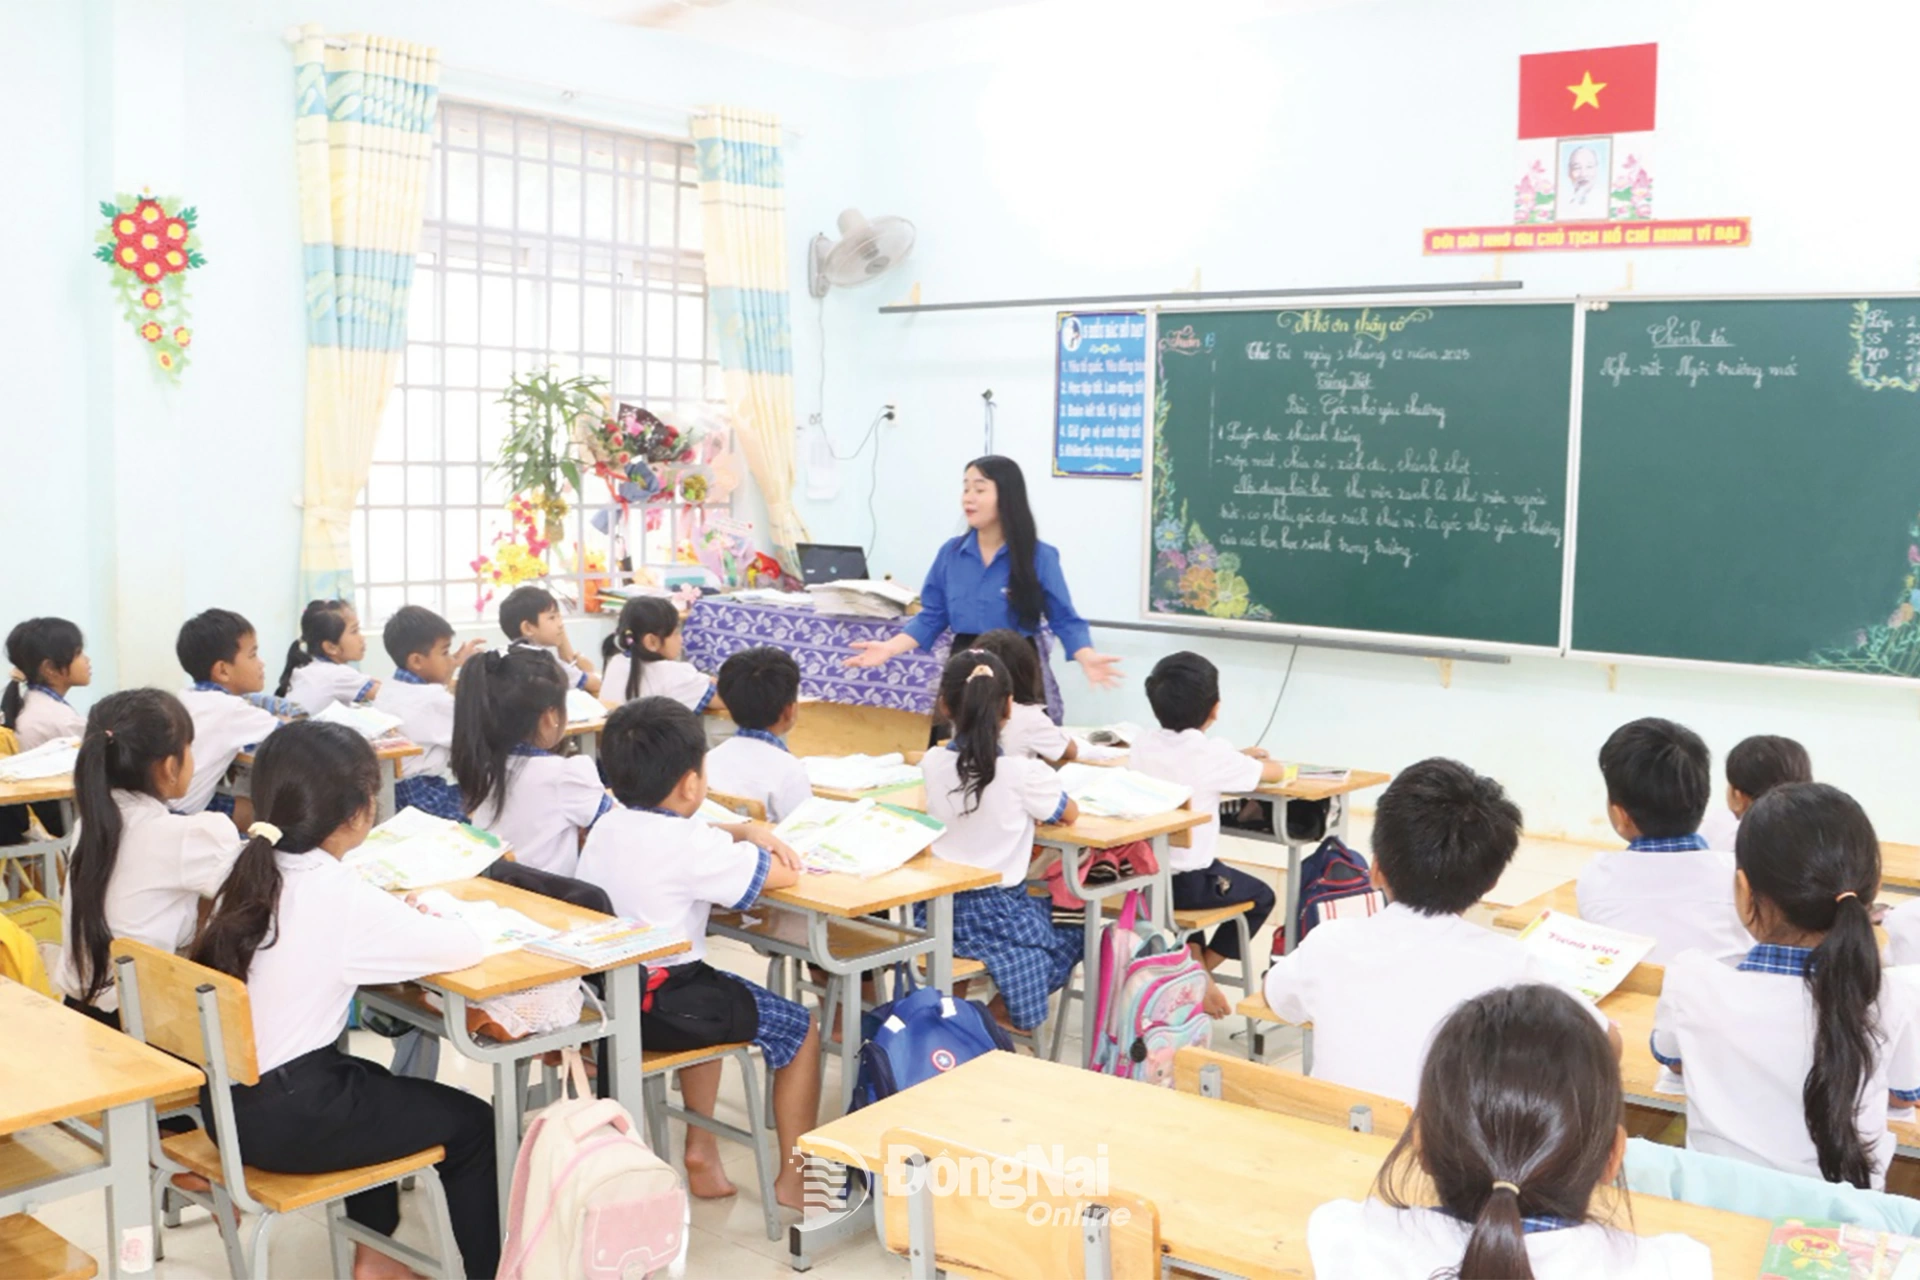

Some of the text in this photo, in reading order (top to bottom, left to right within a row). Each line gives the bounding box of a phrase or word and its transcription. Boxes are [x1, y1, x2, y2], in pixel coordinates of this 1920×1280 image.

[1536, 227, 1565, 246] CHỦ
[1568, 230, 1599, 248] TỊCH
[1602, 225, 1622, 244] HỒ
[1624, 226, 1651, 244] CHÍ
[1645, 315, 1703, 345] Chính
[1245, 341, 1272, 360] Thứ
